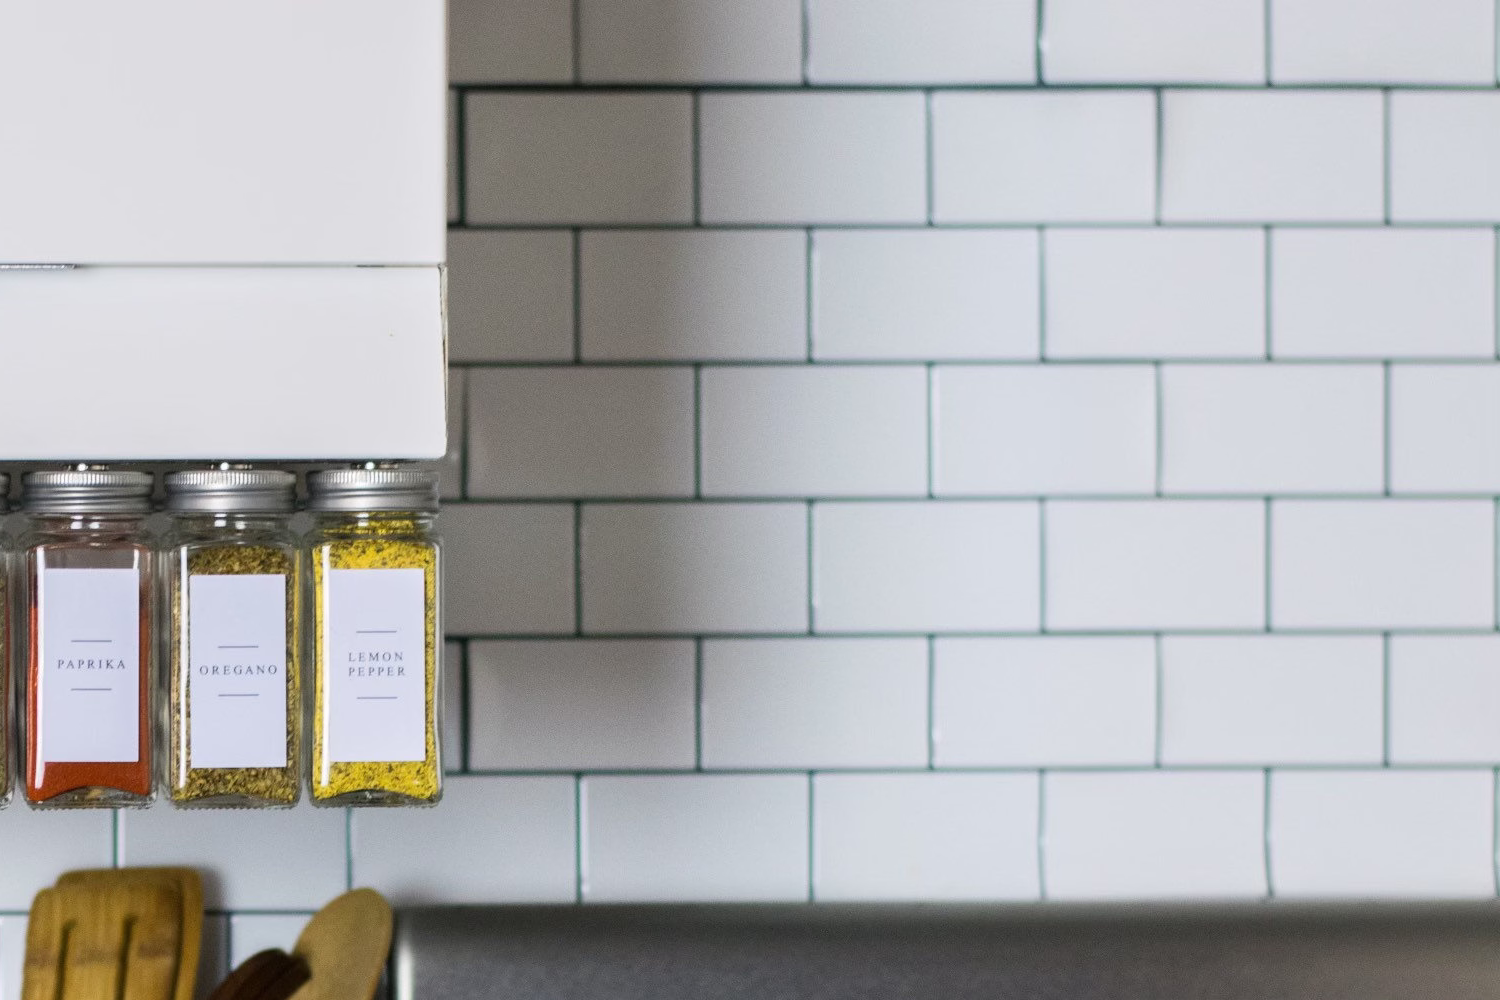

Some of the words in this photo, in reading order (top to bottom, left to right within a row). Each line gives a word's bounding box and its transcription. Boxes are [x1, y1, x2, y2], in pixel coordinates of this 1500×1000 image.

[348, 651, 403, 662] LEMON
[57, 659, 126, 670] PAPRIKA
[199, 664, 278, 676] OREGANO
[348, 666, 405, 677] PEPPER
